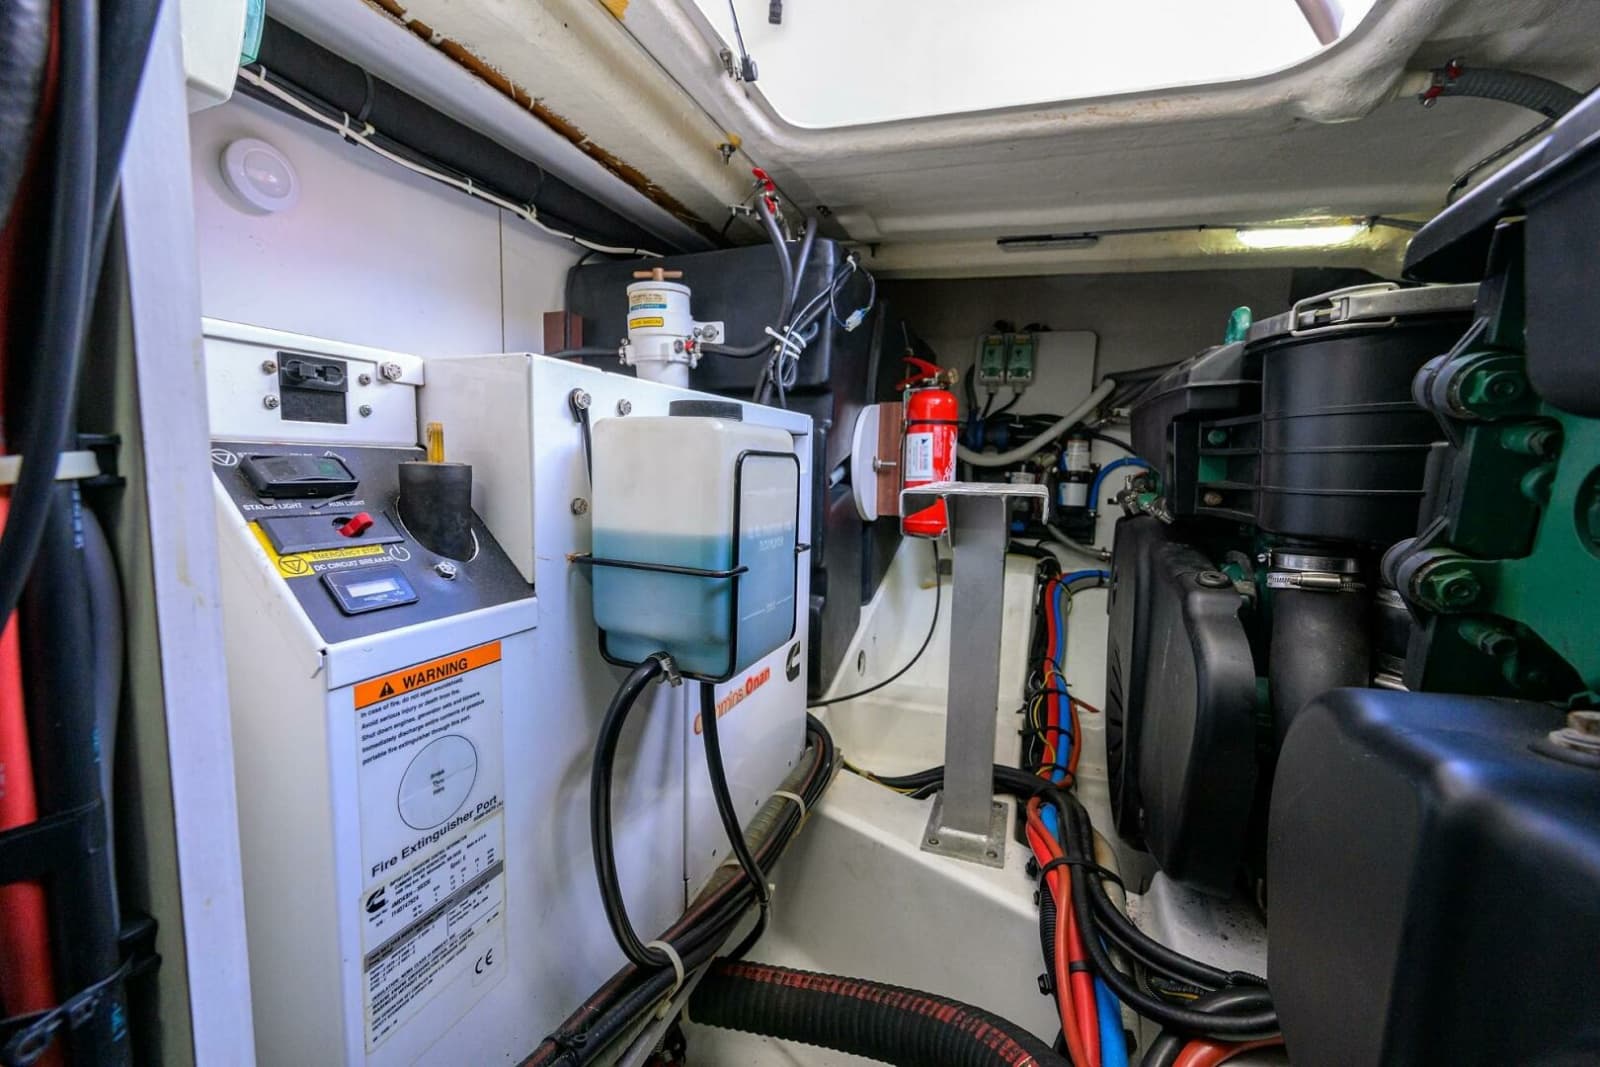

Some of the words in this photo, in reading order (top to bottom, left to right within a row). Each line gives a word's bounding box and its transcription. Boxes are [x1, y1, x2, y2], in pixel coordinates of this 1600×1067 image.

[279, 502, 303, 510] LIGHT
[314, 564, 327, 572] DC
[327, 560, 357, 569] CIRCUIT
[358, 555, 393, 565] BREAKER
[402, 657, 468, 690] WARNING
[745, 666, 770, 696] Onan
[371, 855, 398, 878] Fire
[401, 809, 474, 861] Extinguisher
[475, 795, 498, 815] Port
